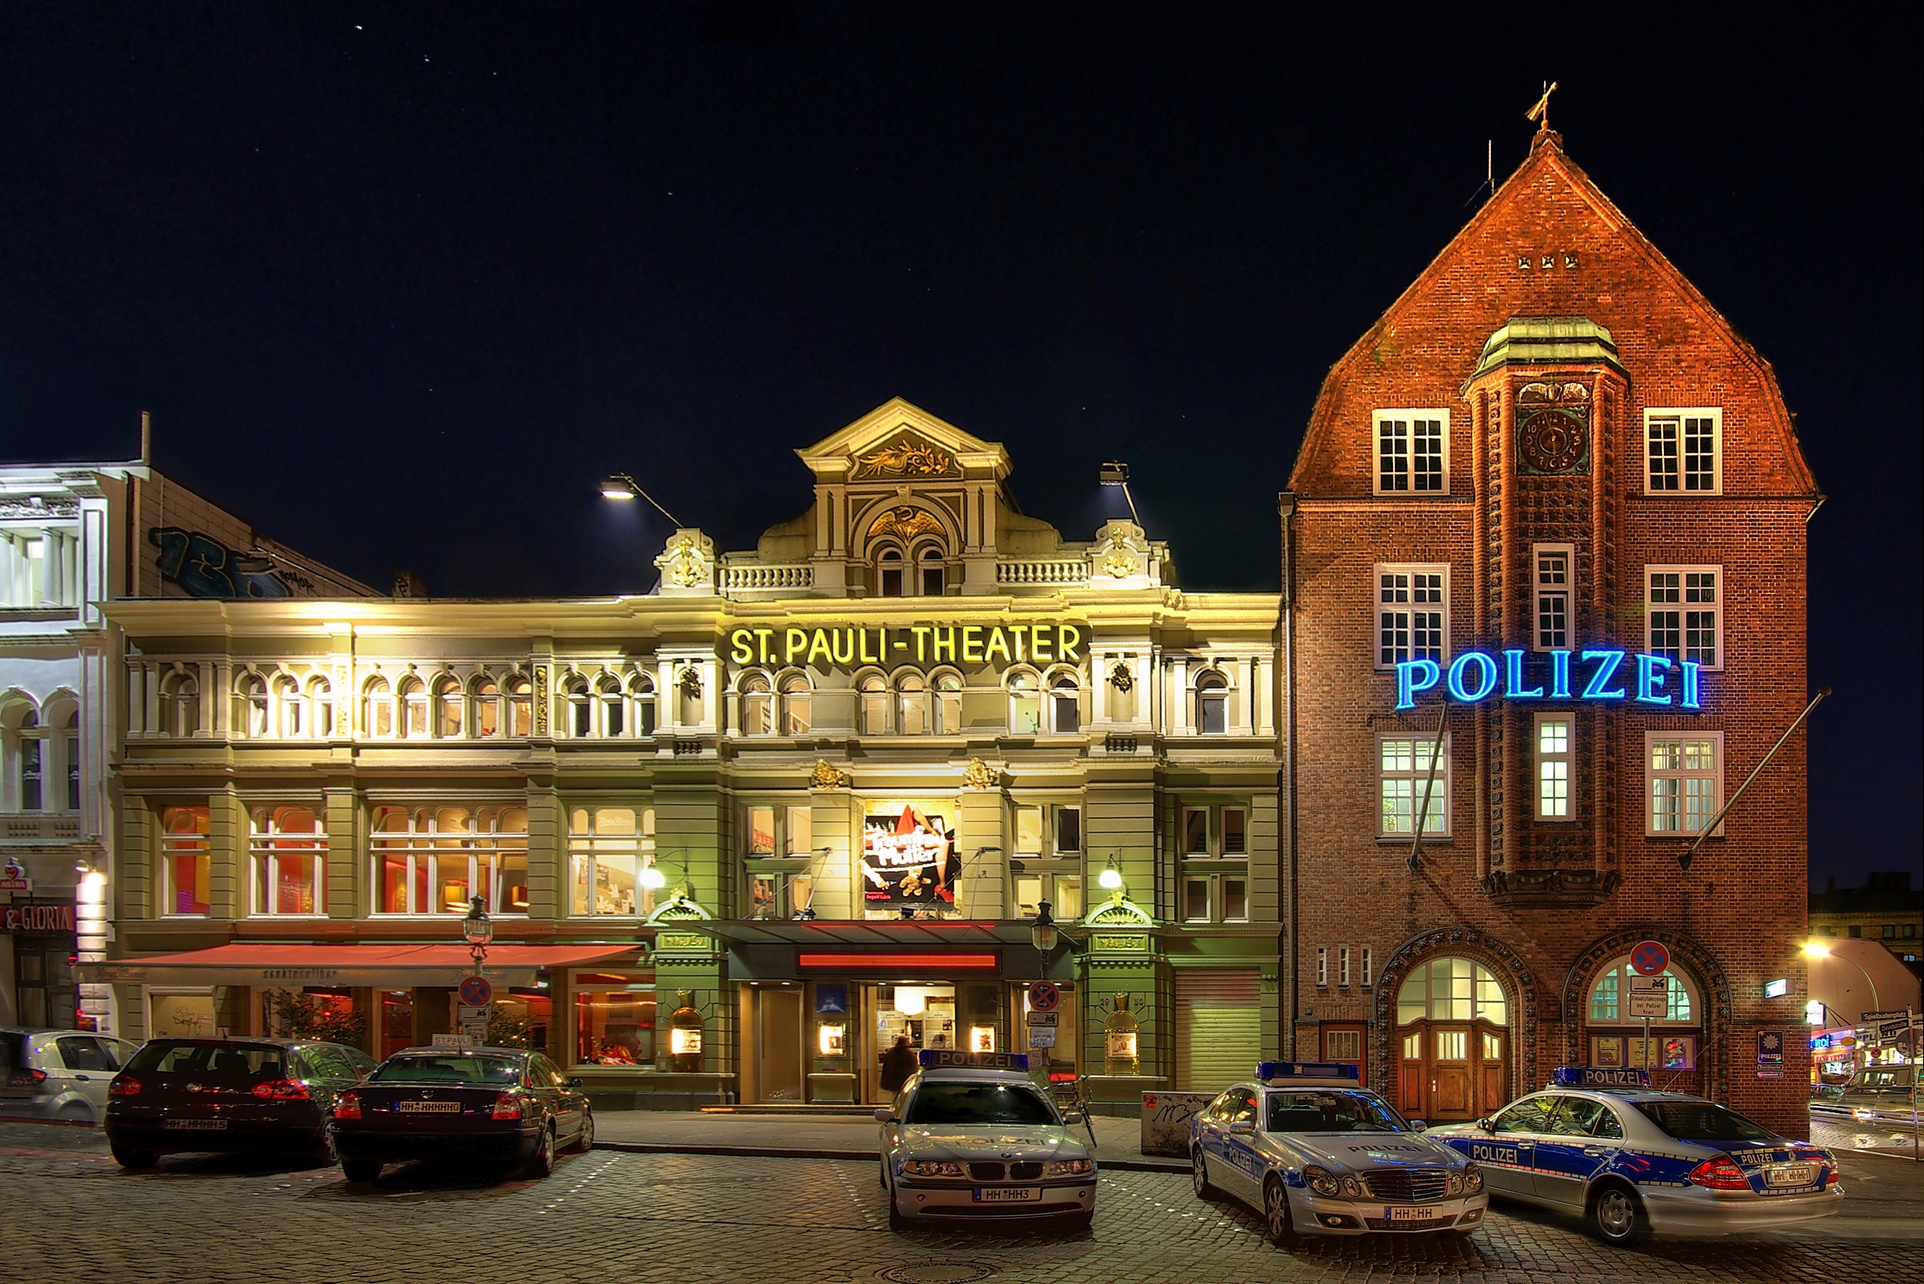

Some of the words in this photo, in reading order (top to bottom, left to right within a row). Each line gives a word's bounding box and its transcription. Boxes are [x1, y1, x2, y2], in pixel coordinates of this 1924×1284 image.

[1395, 649, 1700, 712] POLIZEI
[865, 825, 946, 852] Traumfrau
[878, 845, 940, 866] Mutter
[6, 909, 20, 930] &
[22, 905, 71, 930] GLORIA
[1863, 1012, 1907, 1020] Spielbudenplatz
[940, 1052, 1012, 1067] POLIZEI
[1585, 1070, 1640, 1085] POLIZEI
[401, 1103, 414, 1111] HH
[1347, 1145, 1424, 1153] POLIZEI
[1472, 1145, 1518, 1164] POLIZEI
[1228, 1146, 1252, 1172] POLIZEI
[1740, 1153, 1775, 1165] POLIZEI
[986, 1190, 1000, 1200] HH
[1008, 1190, 1029, 1199] HH3
[1395, 1209, 1410, 1219] HH
[1417, 1208, 1432, 1218] HH
